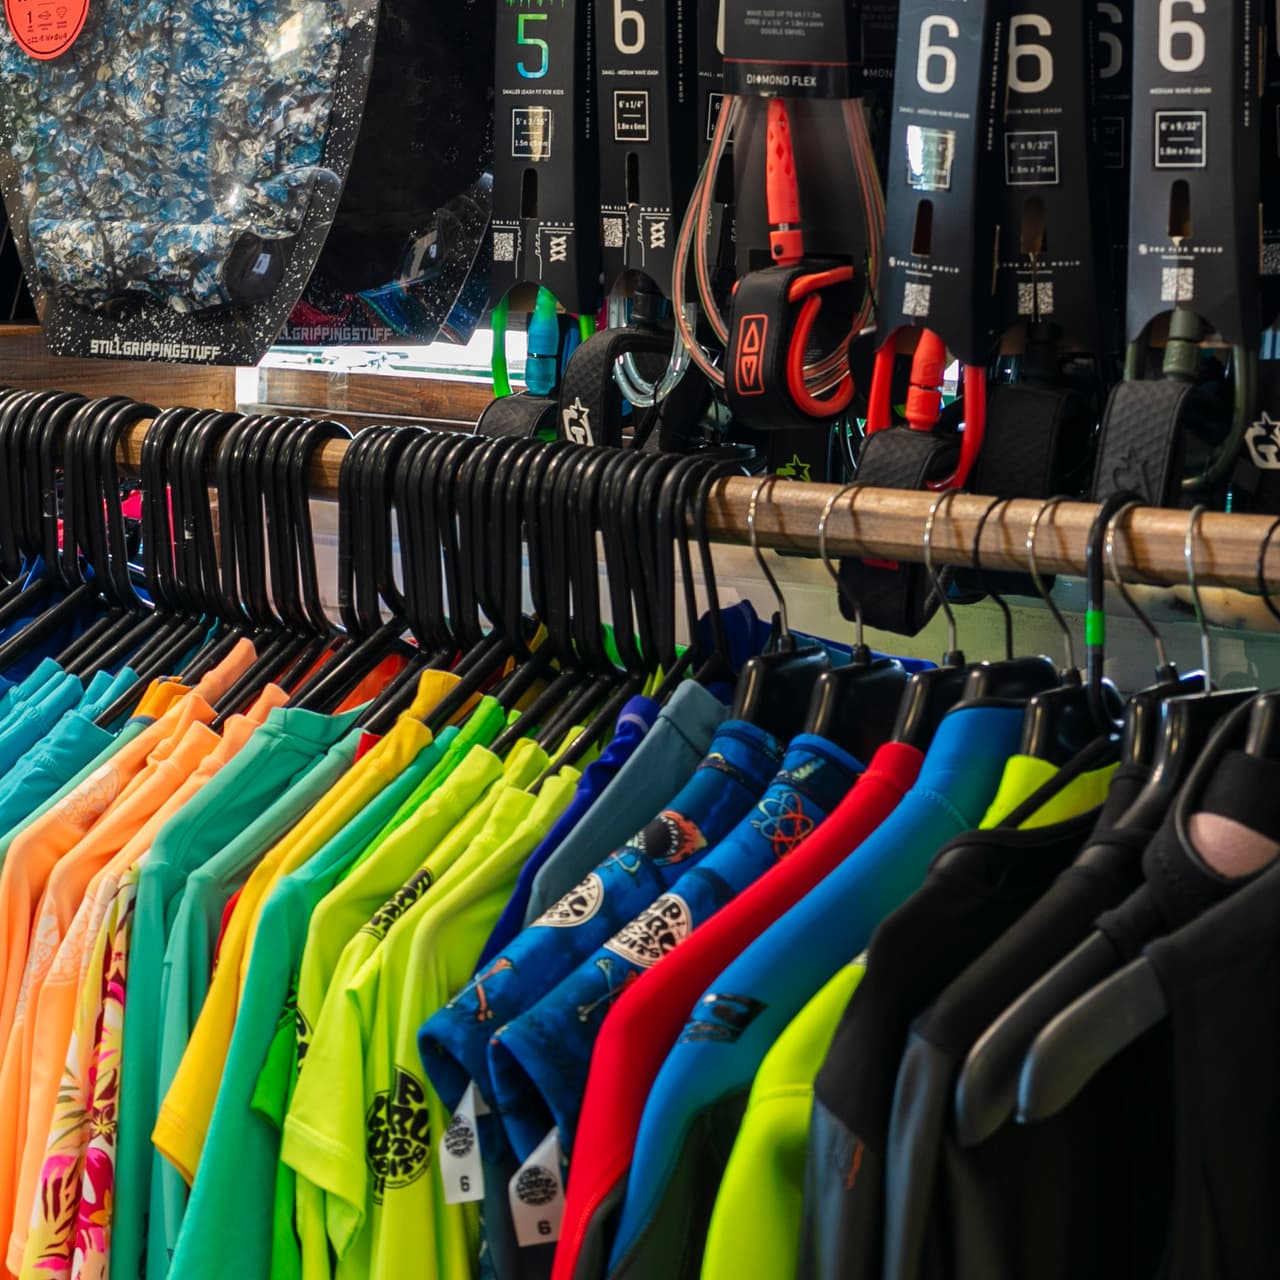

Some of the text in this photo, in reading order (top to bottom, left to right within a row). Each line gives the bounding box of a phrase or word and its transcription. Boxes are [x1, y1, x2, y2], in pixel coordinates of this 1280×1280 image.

[516, 13, 549, 79] 5
[1008, 13, 1054, 94] 6
[916, 14, 959, 94] 6
[791, 74, 817, 88] FLEX
[1176, 121, 1201, 132] 9/32"
[1027, 140, 1053, 151] 9/32"
[1184, 147, 1202, 155] 7mm
[1036, 165, 1055, 174] 7mm
[90, 338, 222, 362] STILLGRIPPINGSTUFF
[459, 1175, 471, 1192] 6
[537, 1220, 552, 1235] 6
